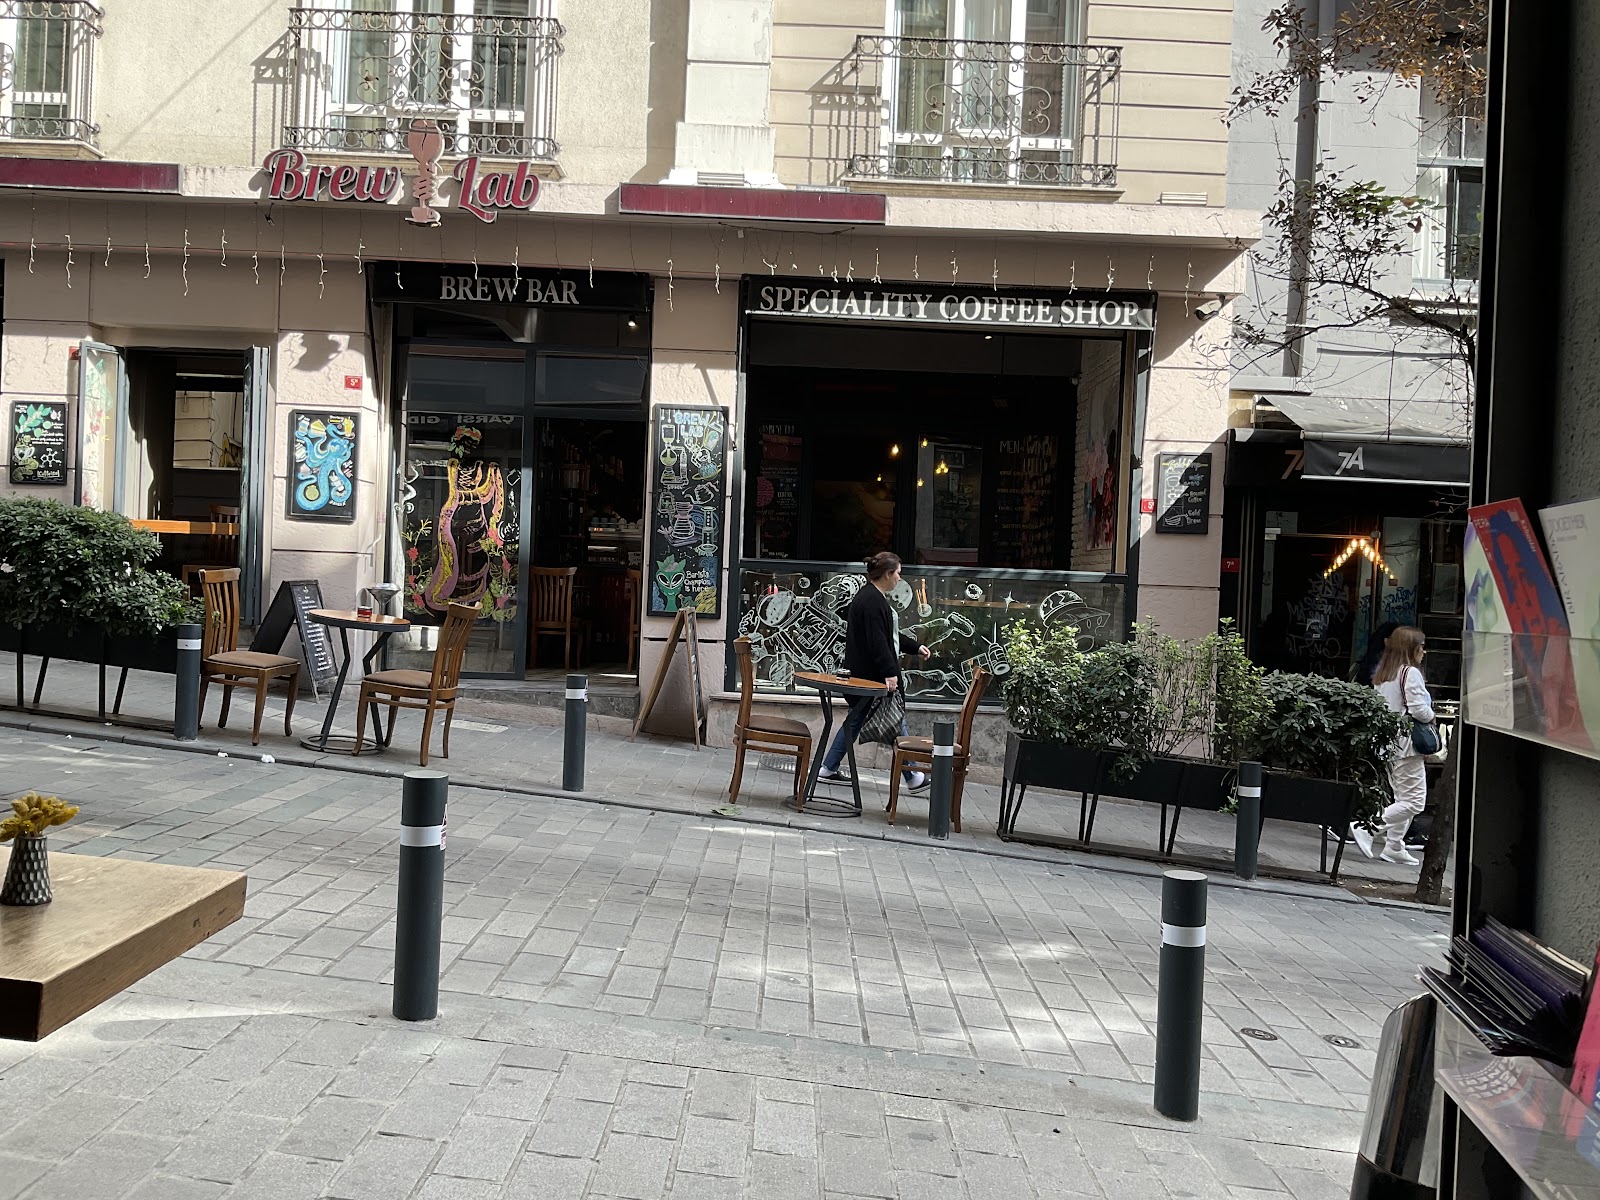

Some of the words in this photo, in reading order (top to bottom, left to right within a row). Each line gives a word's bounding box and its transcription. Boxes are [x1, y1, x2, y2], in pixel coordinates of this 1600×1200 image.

[263, 149, 400, 201] Brew
[453, 156, 542, 224] Lab
[440, 275, 518, 302] BREW
[526, 278, 580, 305] BAR
[760, 285, 932, 319] SPECIALITY
[939, 294, 1053, 323] COFFEE
[1059, 299, 1139, 327] SHOP
[675, 411, 711, 427] BREW
[681, 424, 704, 438] LAB
[1334, 446, 1365, 476] 7A
